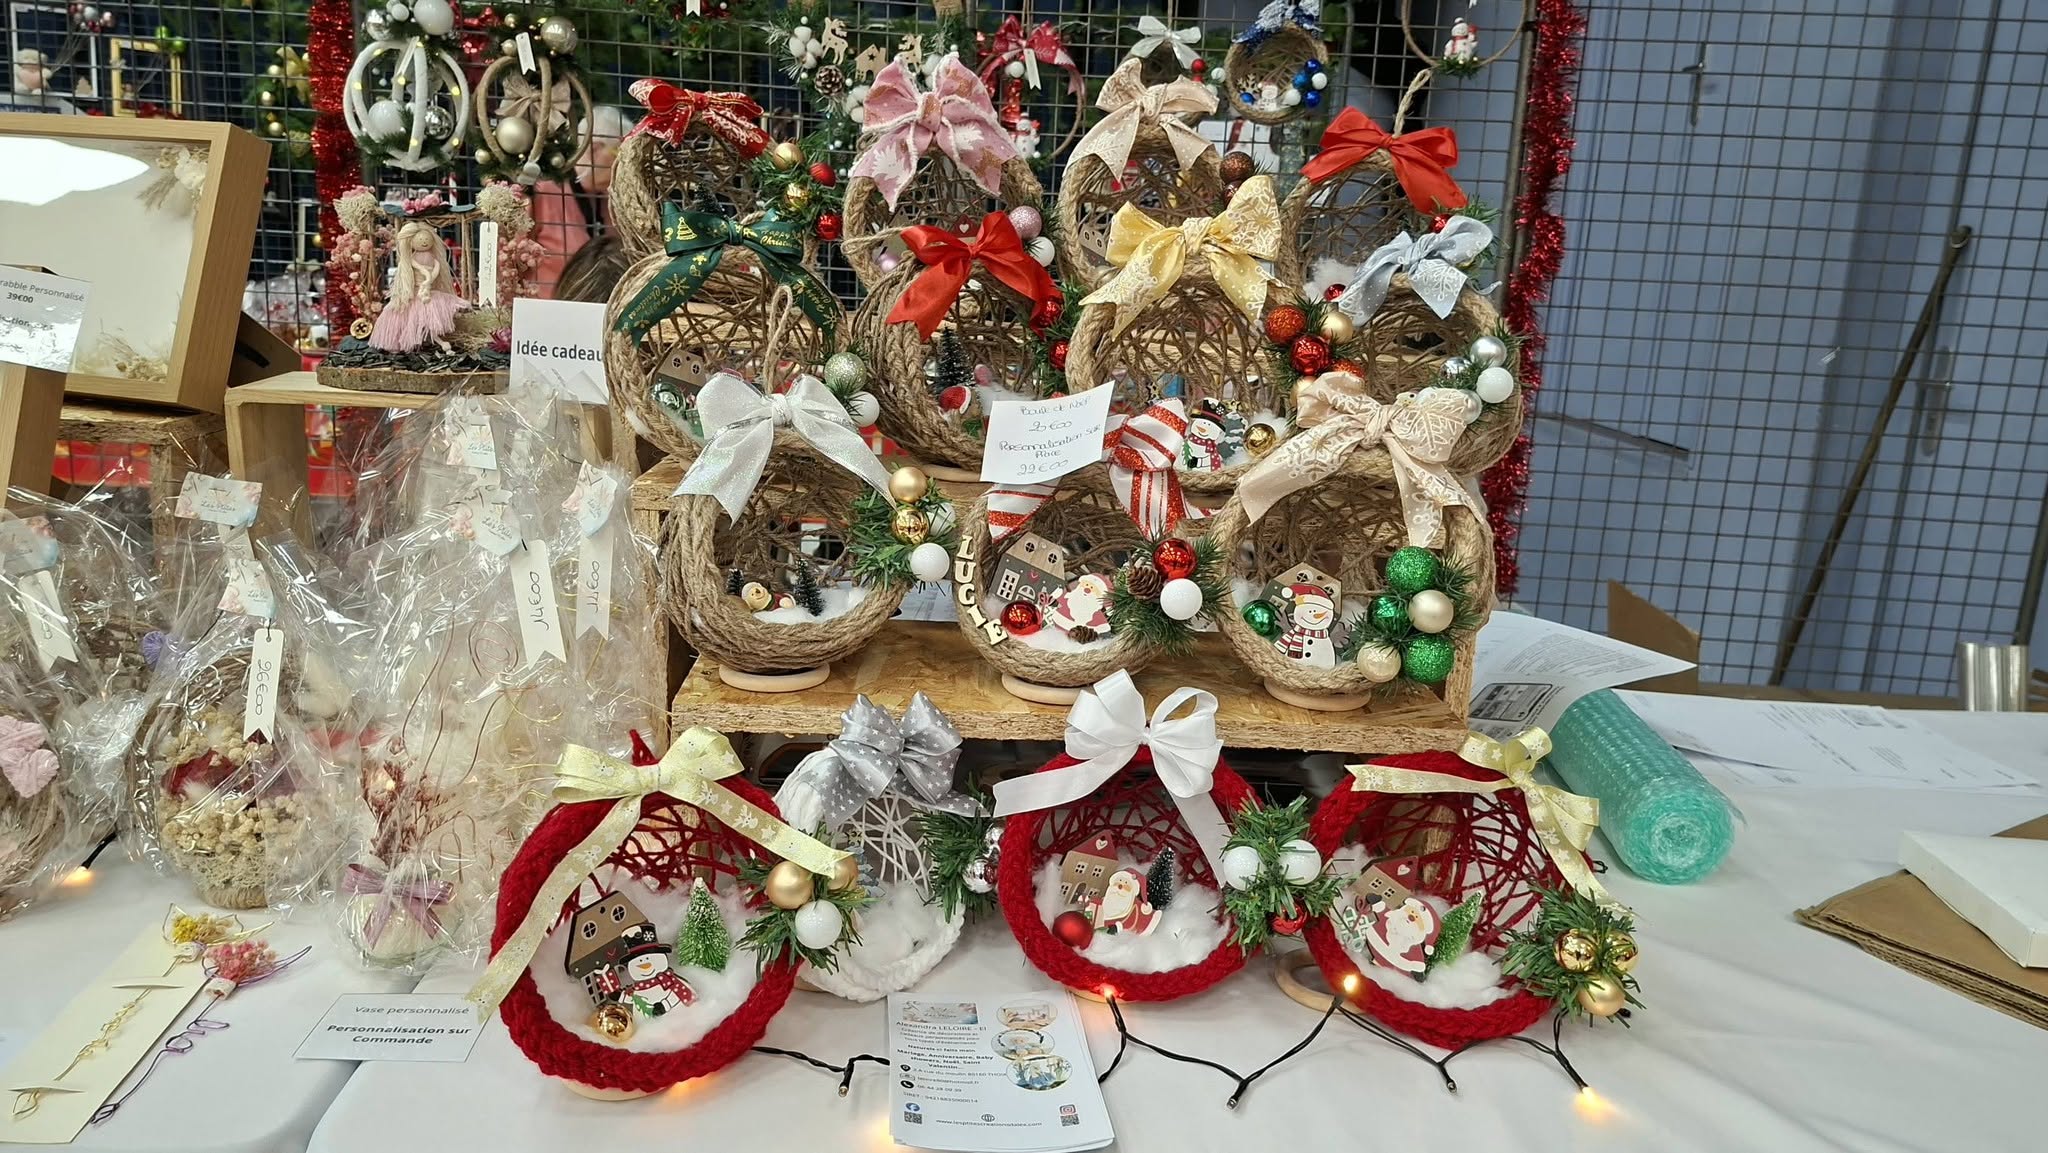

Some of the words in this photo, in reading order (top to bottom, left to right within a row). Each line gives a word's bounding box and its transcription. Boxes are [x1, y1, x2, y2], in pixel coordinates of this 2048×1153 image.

[6, 292, 34, 303] 39€00
[517, 340, 547, 356] Idée
[256, 659, 272, 715] 26€00
[387, 1006, 470, 1015] personnalisé
[327, 1025, 445, 1034] Personnalisation
[896, 1022, 936, 1030] Alexandra
[352, 1036, 433, 1044] Commande
